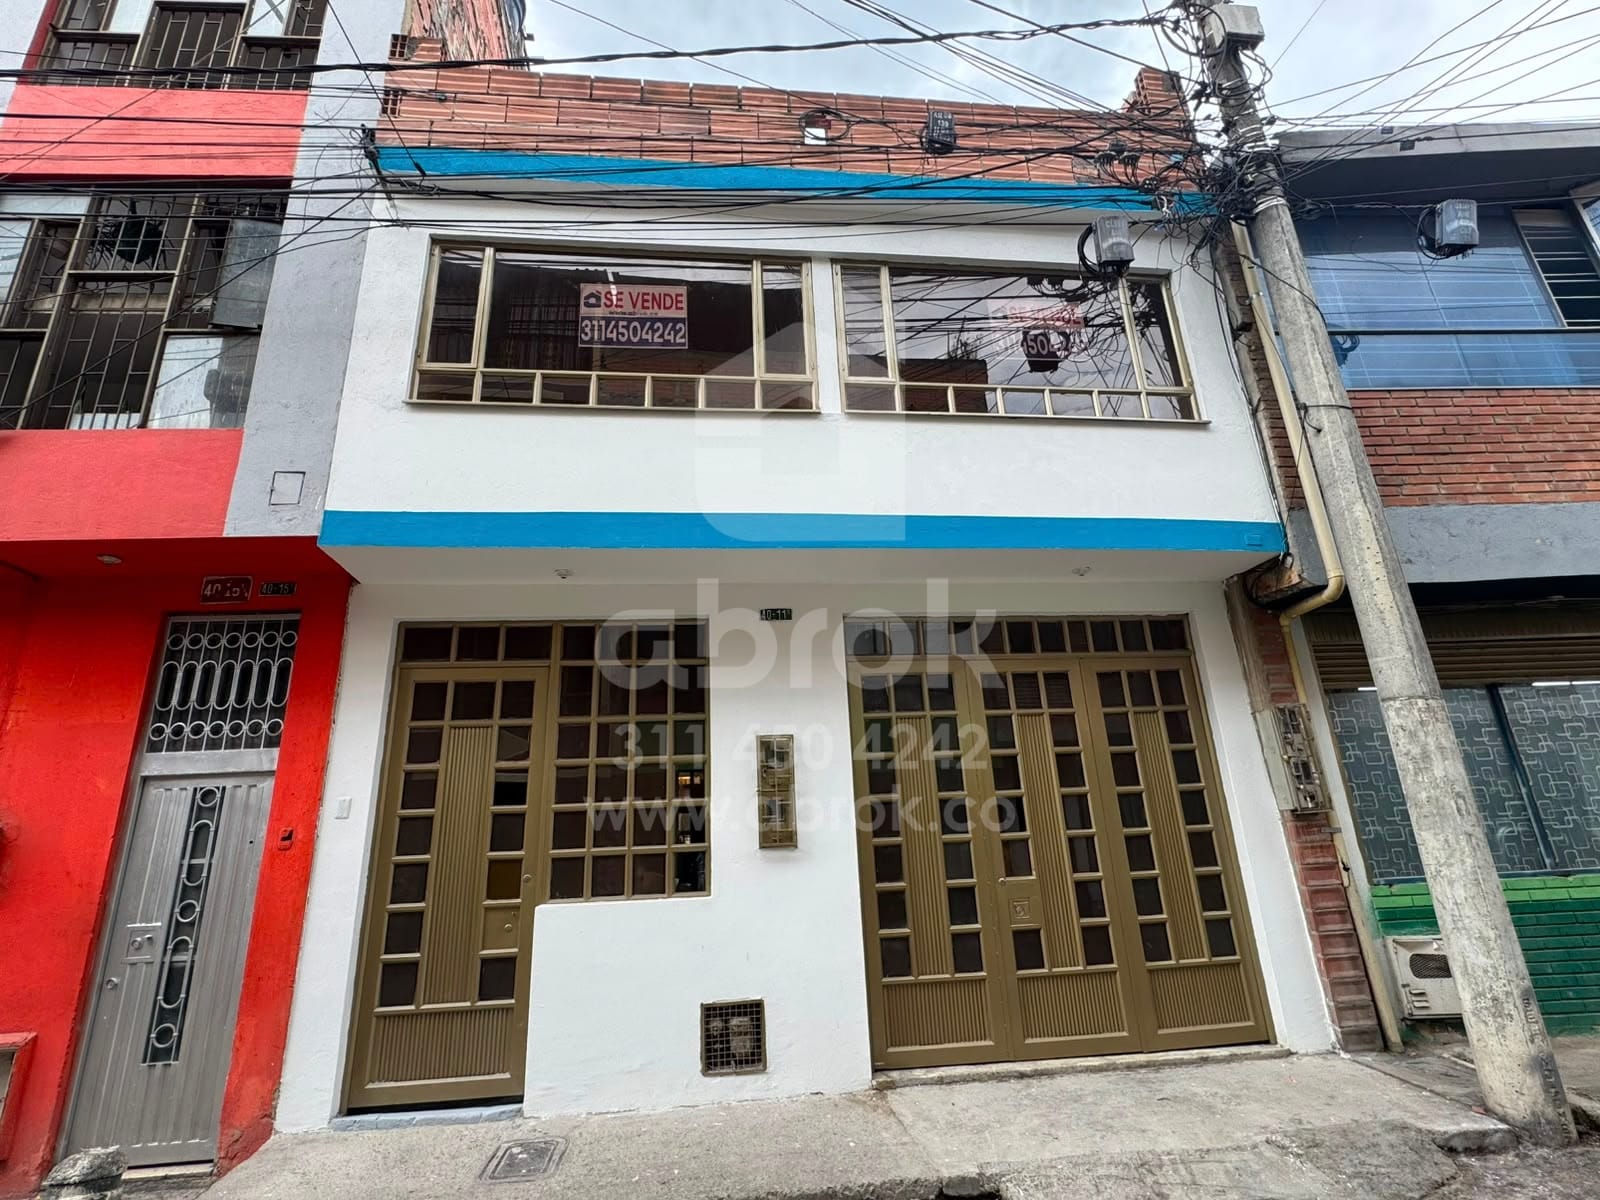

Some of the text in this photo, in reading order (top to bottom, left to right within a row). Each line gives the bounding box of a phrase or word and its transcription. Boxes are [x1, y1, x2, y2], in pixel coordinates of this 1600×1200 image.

[603, 290, 685, 311] SE VENDE
[580, 319, 686, 343] 3114504242
